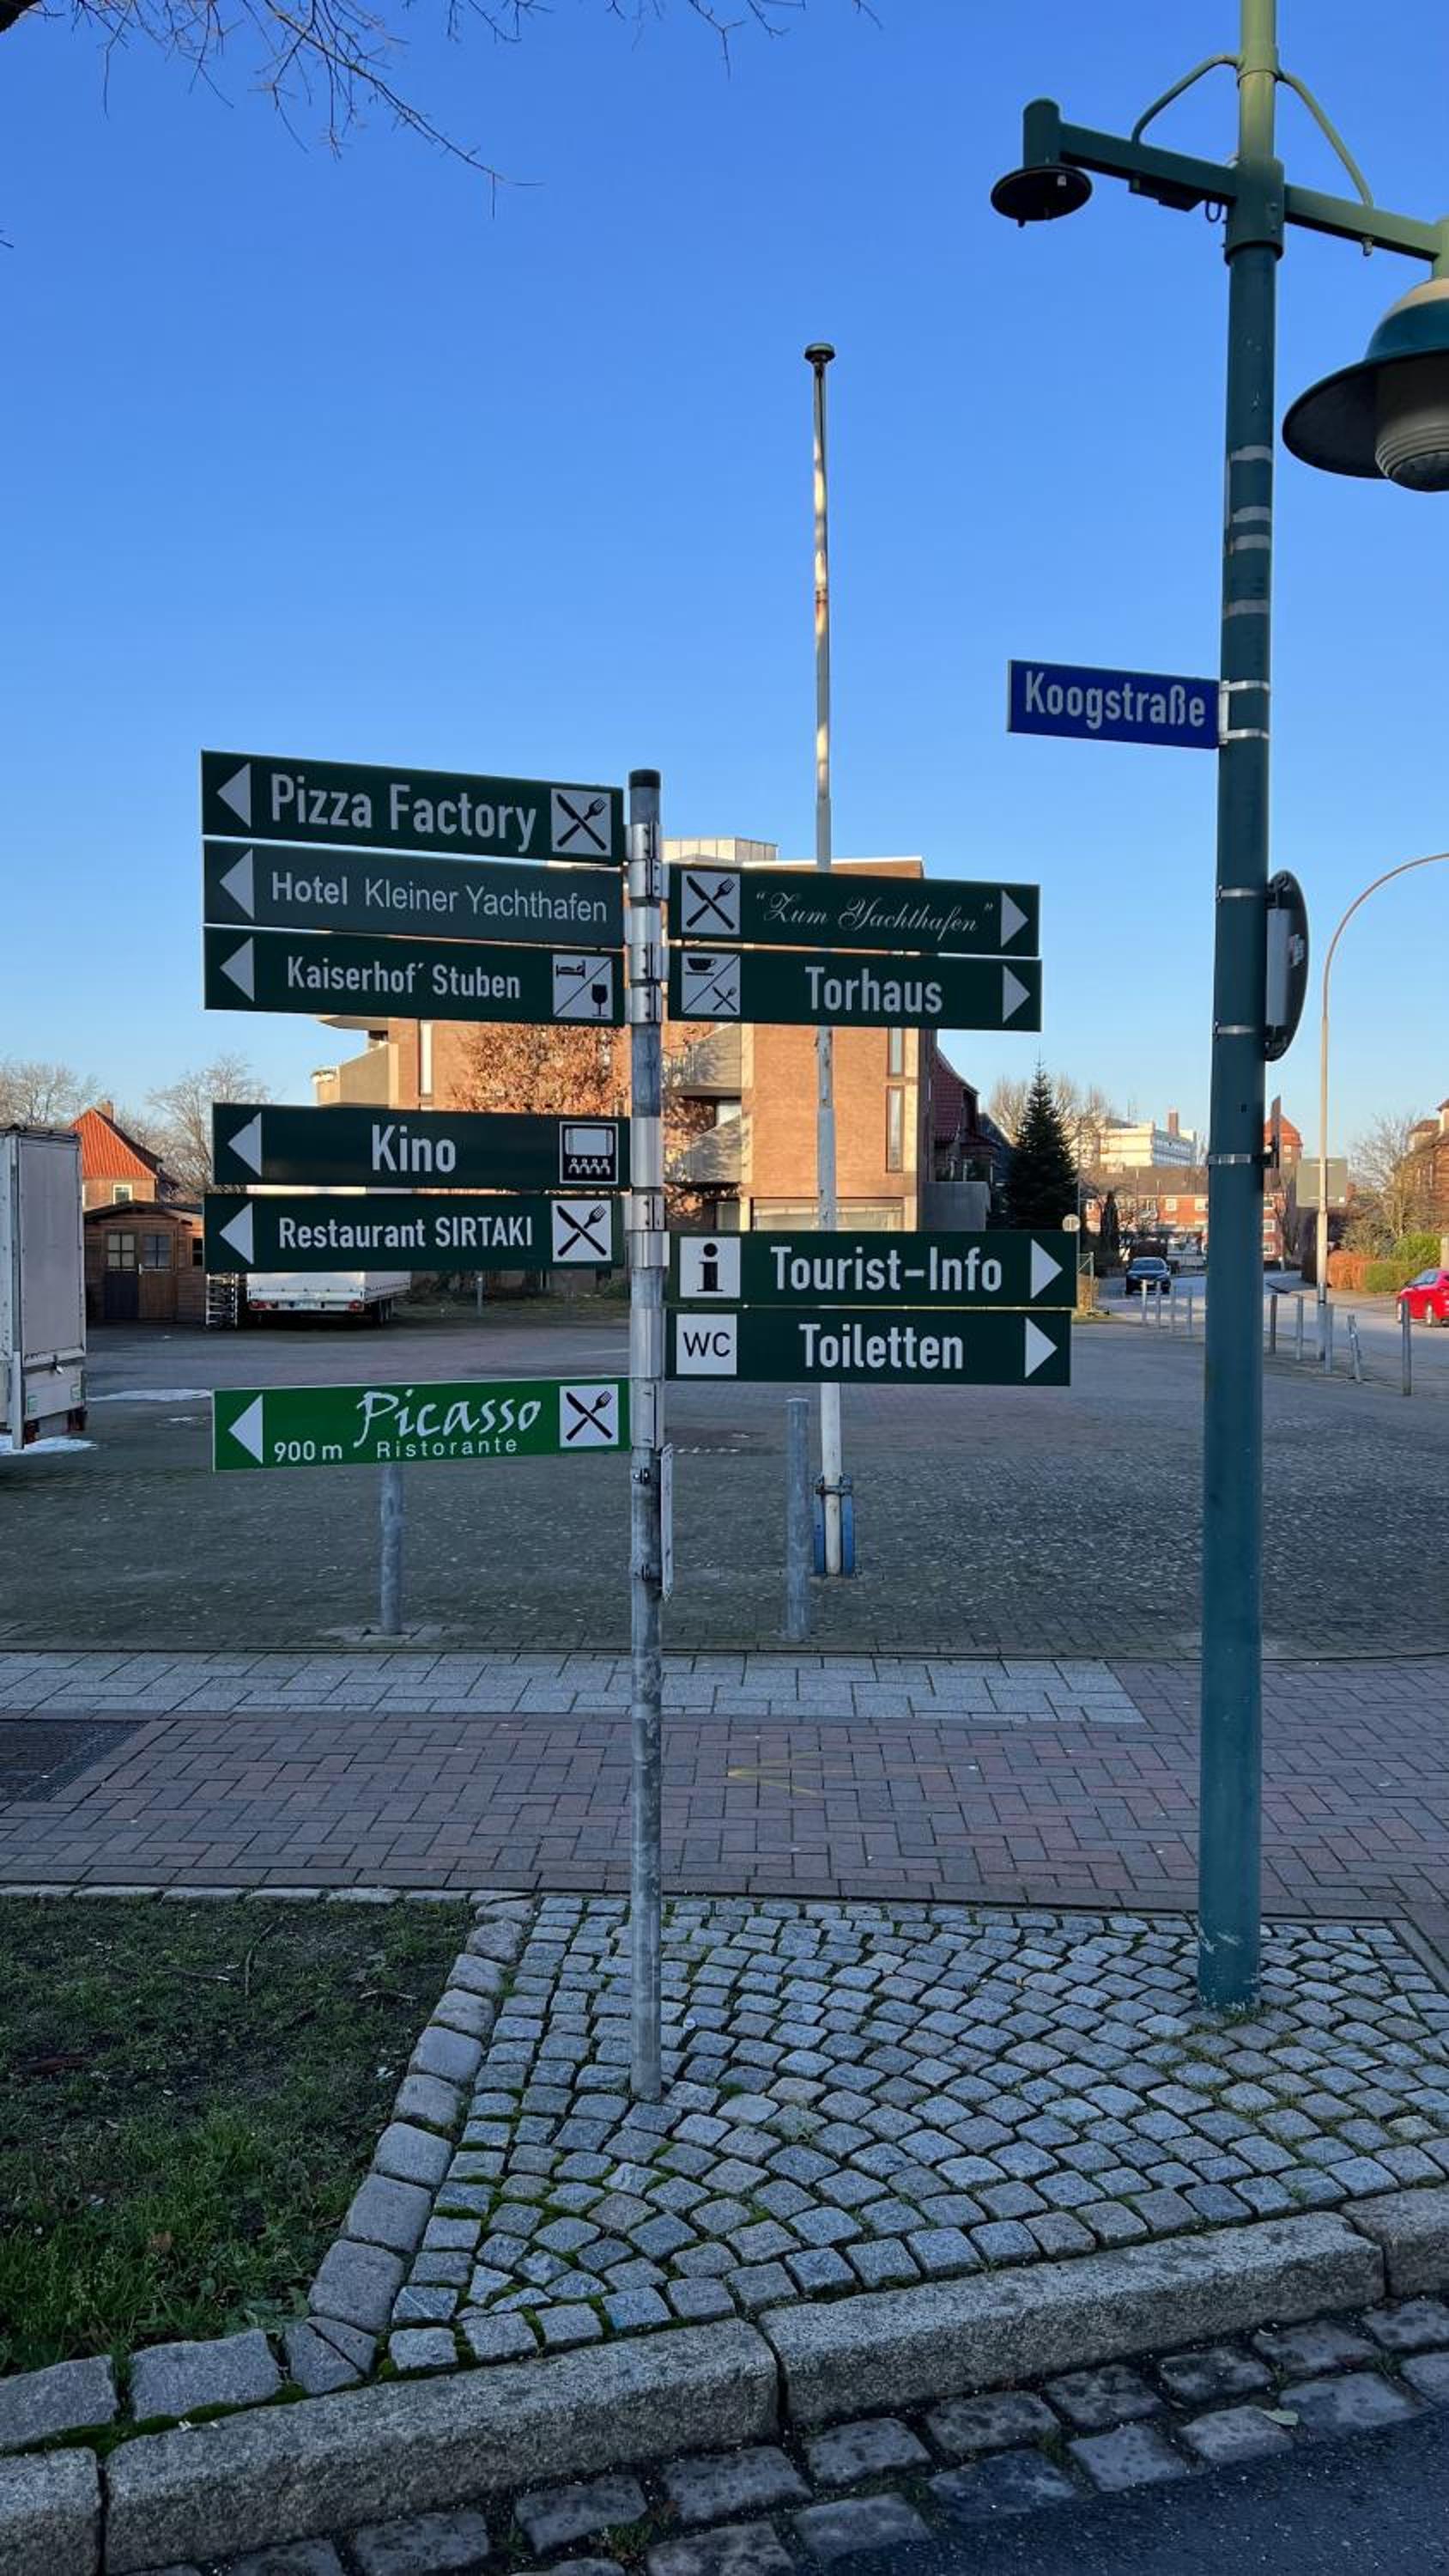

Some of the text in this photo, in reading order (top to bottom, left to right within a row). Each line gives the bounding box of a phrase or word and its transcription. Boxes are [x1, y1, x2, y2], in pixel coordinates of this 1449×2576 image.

[1026, 671, 1206, 729] Koogstraße
[271, 773, 537, 853] Pizza Factory
[271, 871, 608, 922] Hotel Kleiner Yachthafen
[432, 963, 521, 999] Stuben
[804, 966, 943, 1014] Torhaus
[371, 1123, 457, 1173] Kino
[279, 1216, 533, 1249] Restaurant SIRTAKI
[770, 1245, 1003, 1291] Tourist-Info
[682, 1332, 731, 1358] WC
[798, 1322, 964, 1370] Toiletten
[353, 1388, 542, 1449] Picasso
[376, 1436, 518, 1459] Ristorante
